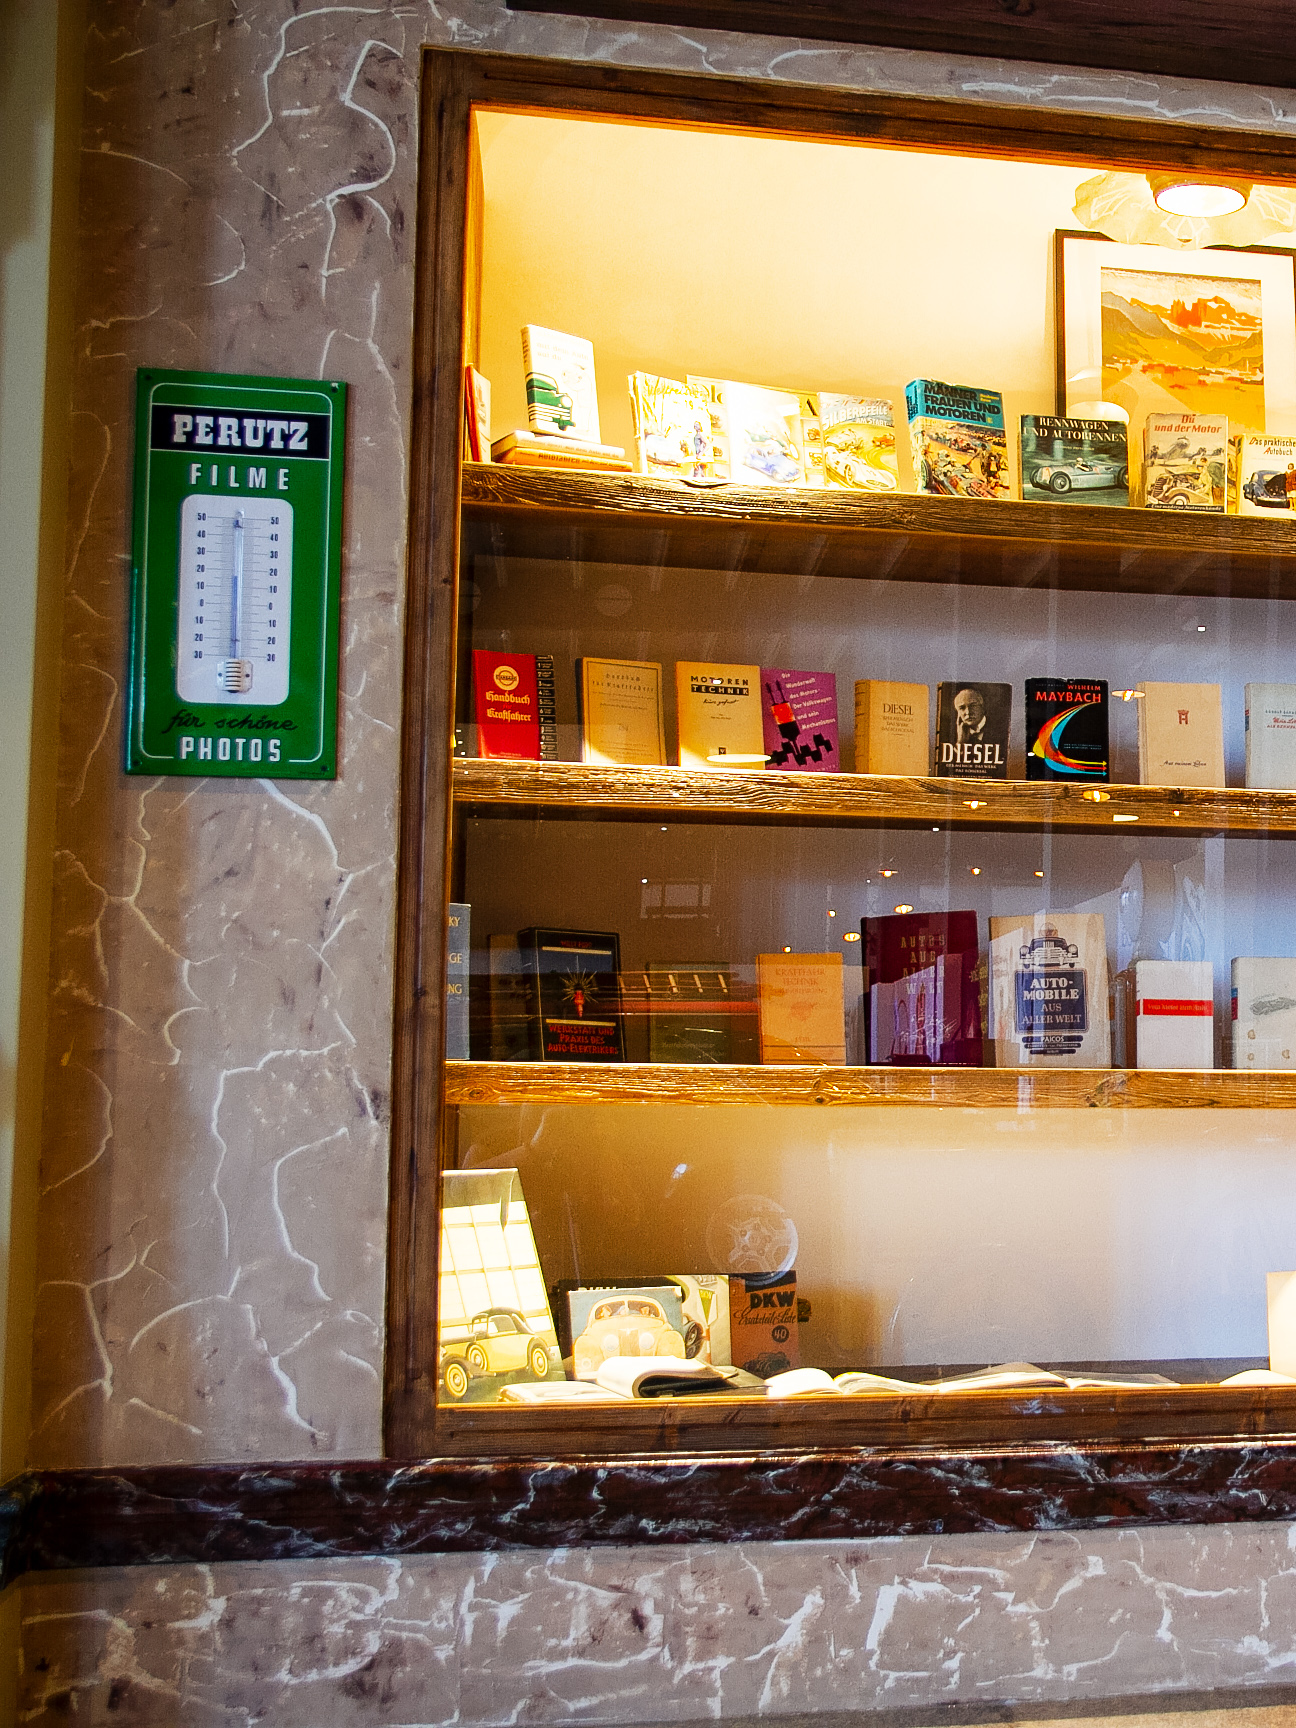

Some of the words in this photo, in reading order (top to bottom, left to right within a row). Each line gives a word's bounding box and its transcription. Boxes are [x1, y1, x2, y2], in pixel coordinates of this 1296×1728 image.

[924, 394, 972, 411] FRAUEN
[974, 401, 1001, 415] UND
[822, 404, 888, 431] SILBERPFEILE
[925, 405, 987, 423] MOTOREN
[1039, 417, 1109, 431] RENNWAGEN
[1154, 424, 1173, 432] und
[1174, 424, 1191, 433] der
[1191, 425, 1222, 434] Motor
[172, 414, 308, 451] PERUTZ
[1023, 427, 1048, 437] UND
[1052, 429, 1127, 442] AUTORENNEN
[1249, 437, 1263, 445] Das
[1263, 438, 1296, 448] praktische
[190, 463, 290, 491] FILME
[197, 513, 206, 521] 50
[271, 517, 279, 525] 50
[197, 530, 206, 538] 40
[270, 534, 278, 542] 40
[197, 547, 205, 555] 30
[270, 551, 278, 559] 30
[196, 564, 205, 572] 20
[269, 568, 278, 576] 20
[269, 585, 277, 593] 10
[200, 599, 204, 607] 0
[268, 602, 273, 610] 0
[195, 616, 203, 624] 10
[268, 619, 276, 627] 10
[195, 633, 203, 641] 20
[267, 637, 276, 645] 20
[267, 654, 275, 662] 30
[692, 685, 749, 695] TECHNIK
[485, 690, 530, 705] Handbuch
[1035, 691, 1102, 703] MAYBACH
[486, 707, 532, 723] Kraftfahrer
[883, 703, 914, 716] DIESEL
[163, 709, 206, 734] für
[214, 713, 299, 732] schöne
[181, 736, 281, 762] PHOTOS
[941, 742, 1005, 764] DIESEL
[900, 933, 945, 949] AUTOS
[910, 950, 936, 963] AUS
[1030, 977, 1074, 989] AUTO-
[1023, 988, 1079, 1000] MOBILE
[1041, 1003, 1062, 1012] AUS
[1022, 1015, 1054, 1025] ALLER
[1055, 1014, 1082, 1023] WELT
[558, 1033, 589, 1044] PRAXIS
[750, 1291, 796, 1309] DKW
[774, 1329, 787, 1339] 40
